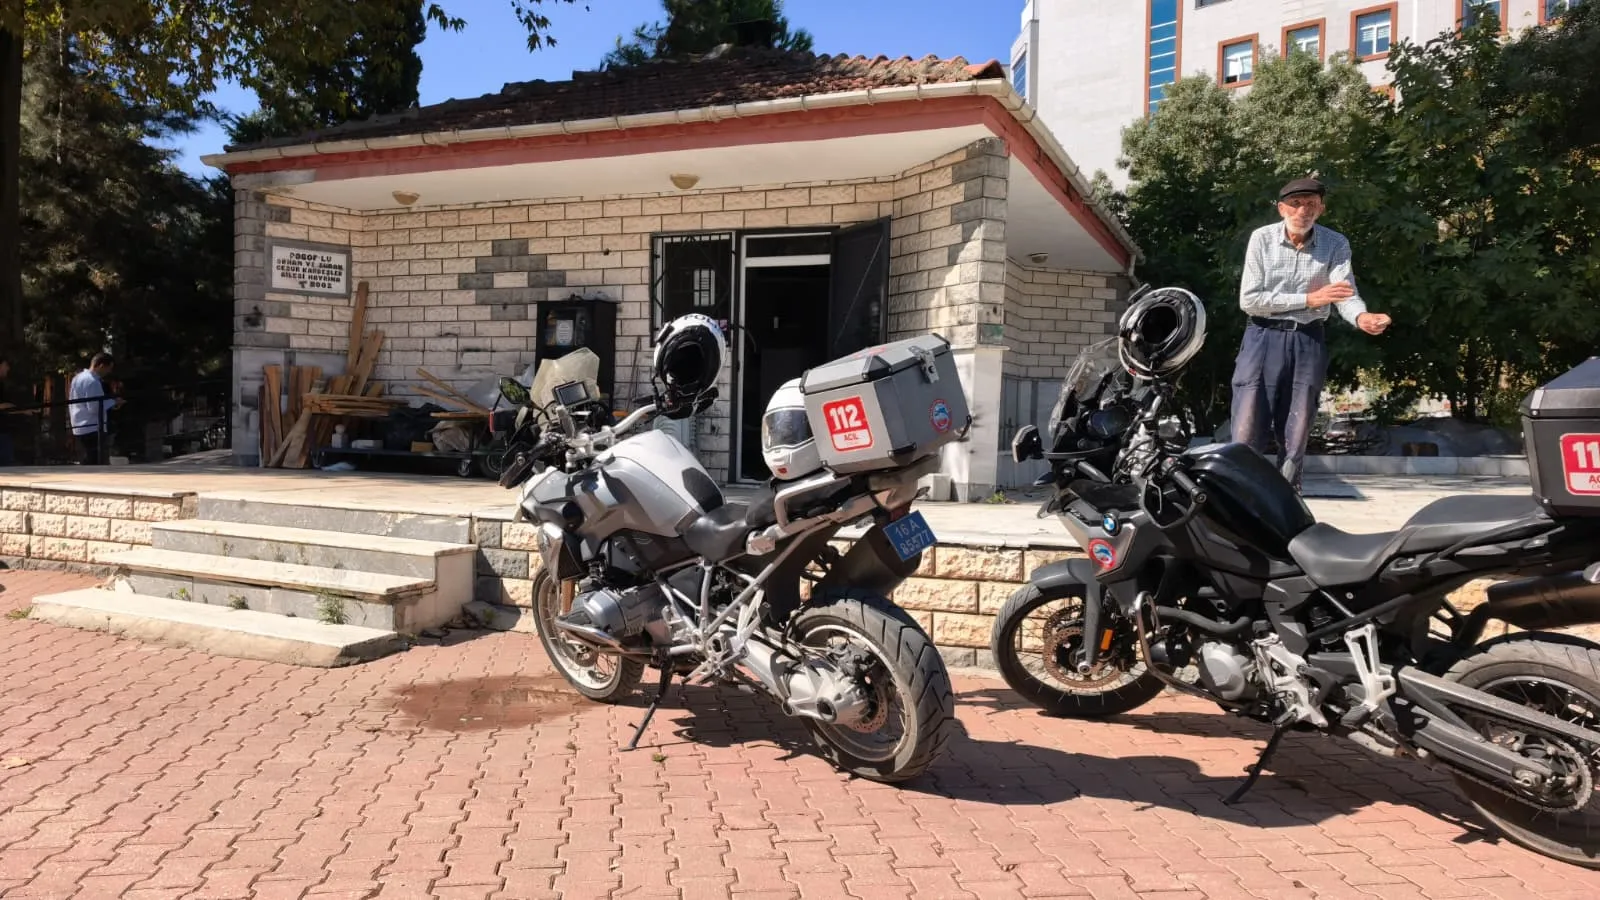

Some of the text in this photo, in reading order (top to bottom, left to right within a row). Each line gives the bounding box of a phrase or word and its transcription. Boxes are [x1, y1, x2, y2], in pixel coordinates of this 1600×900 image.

[829, 404, 862, 430] 112
[895, 518, 920, 538] 16 A
